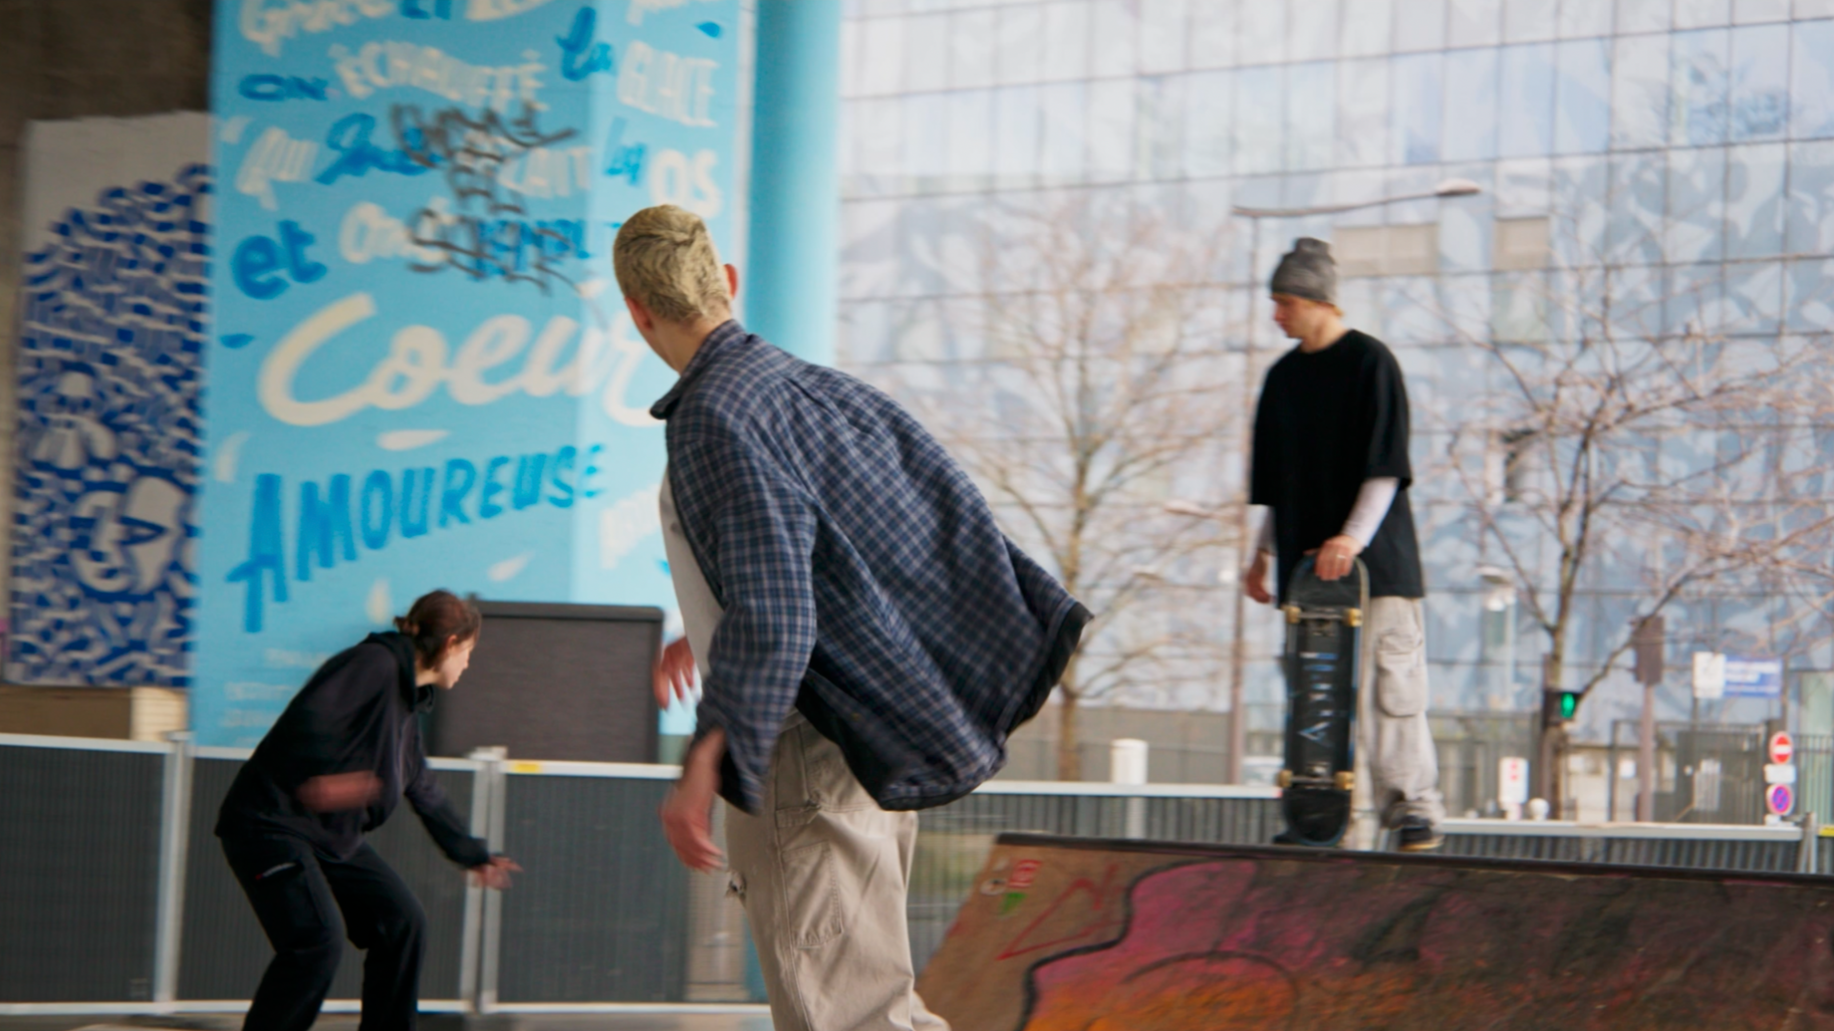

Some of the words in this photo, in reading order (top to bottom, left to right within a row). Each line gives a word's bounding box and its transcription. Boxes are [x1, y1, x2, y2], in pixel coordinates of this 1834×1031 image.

[650, 149, 723, 219] OS
[230, 219, 328, 300] et
[225, 442, 606, 633] AMOUREUSE
